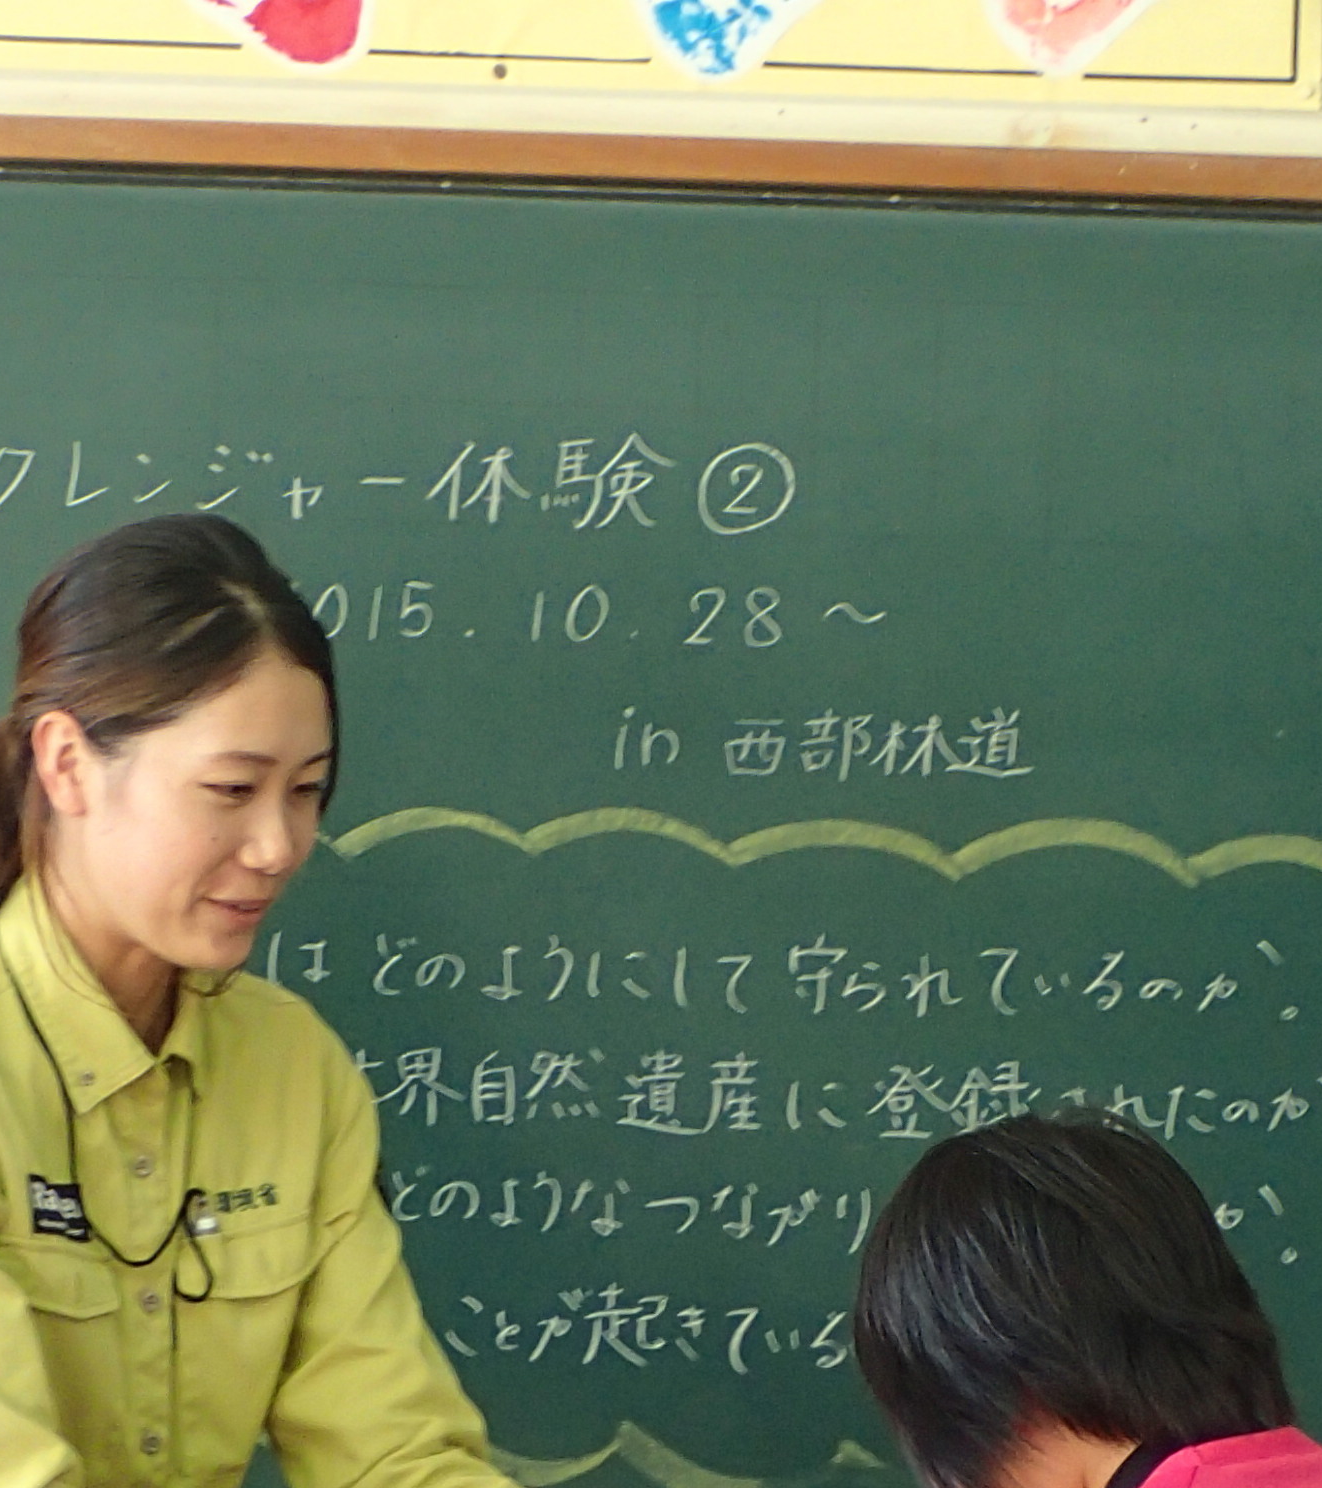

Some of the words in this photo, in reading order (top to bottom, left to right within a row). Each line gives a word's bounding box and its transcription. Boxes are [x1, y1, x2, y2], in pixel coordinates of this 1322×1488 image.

[614, 706, 679, 770] in
[723, 706, 1035, 783] 西部林道
